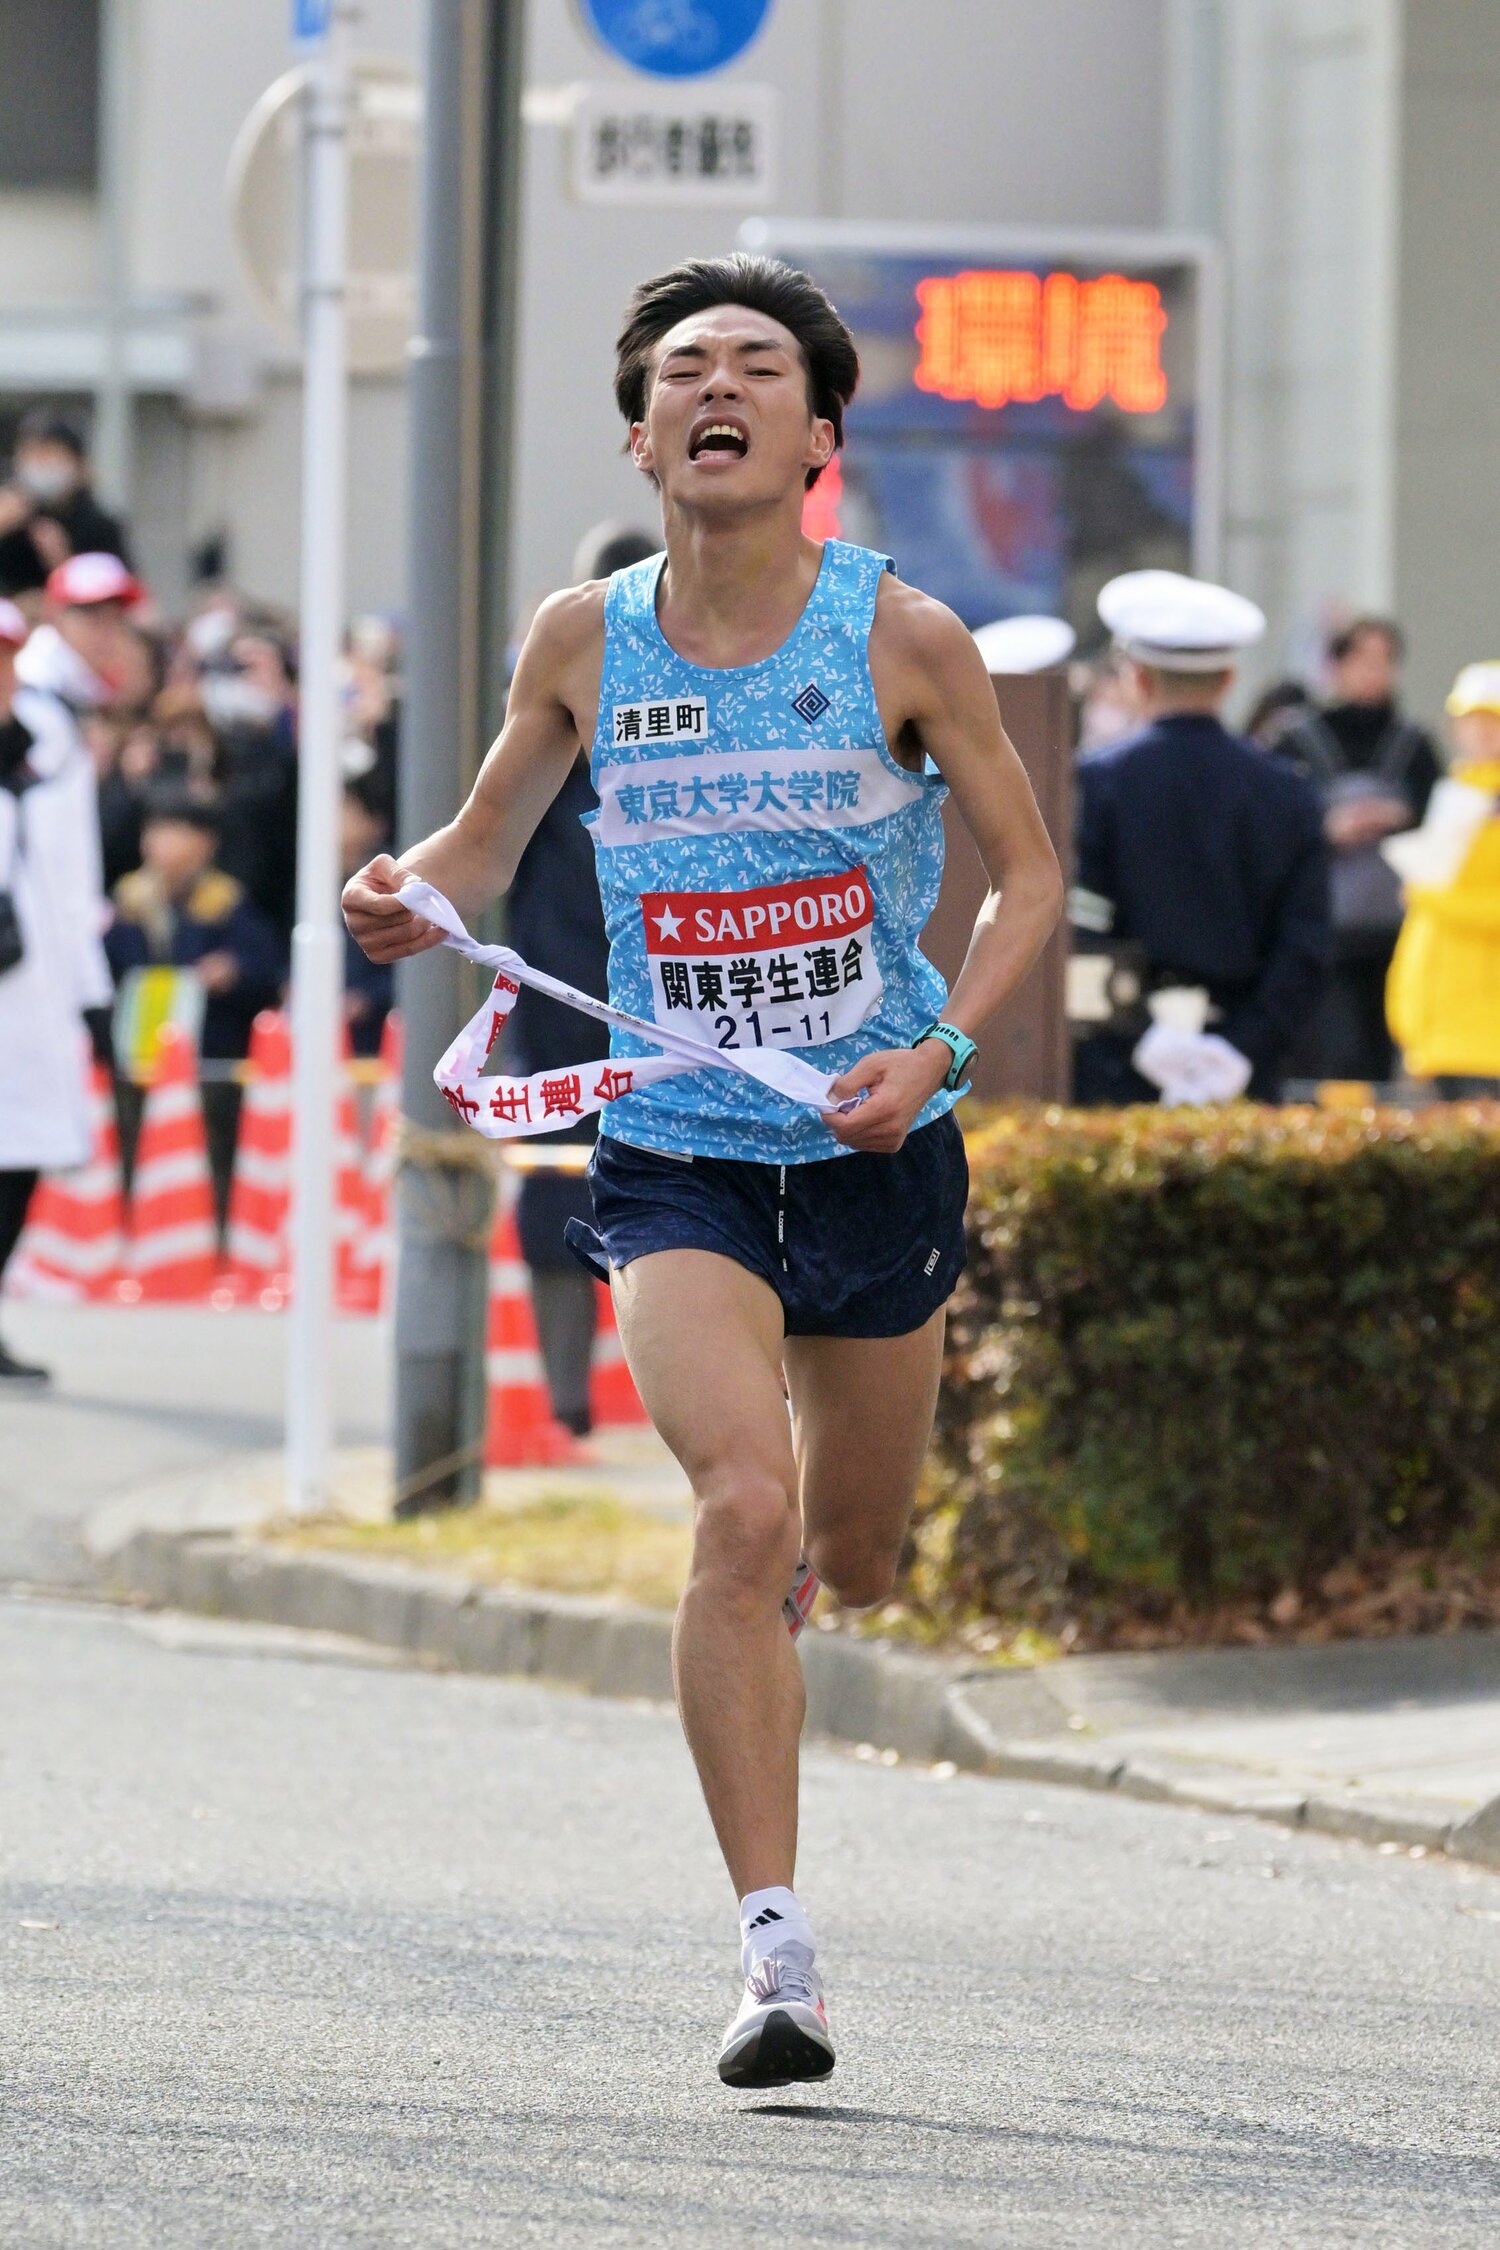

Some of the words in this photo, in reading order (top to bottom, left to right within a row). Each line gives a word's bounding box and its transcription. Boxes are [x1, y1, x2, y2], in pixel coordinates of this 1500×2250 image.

[615, 704, 706, 742] 清里町
[615, 769, 861, 826] 東京大学大学院
[695, 885, 866, 943] SAPPORO
[660, 938, 864, 1012] 関東学生連合
[714, 1011, 830, 1049] 21-11
